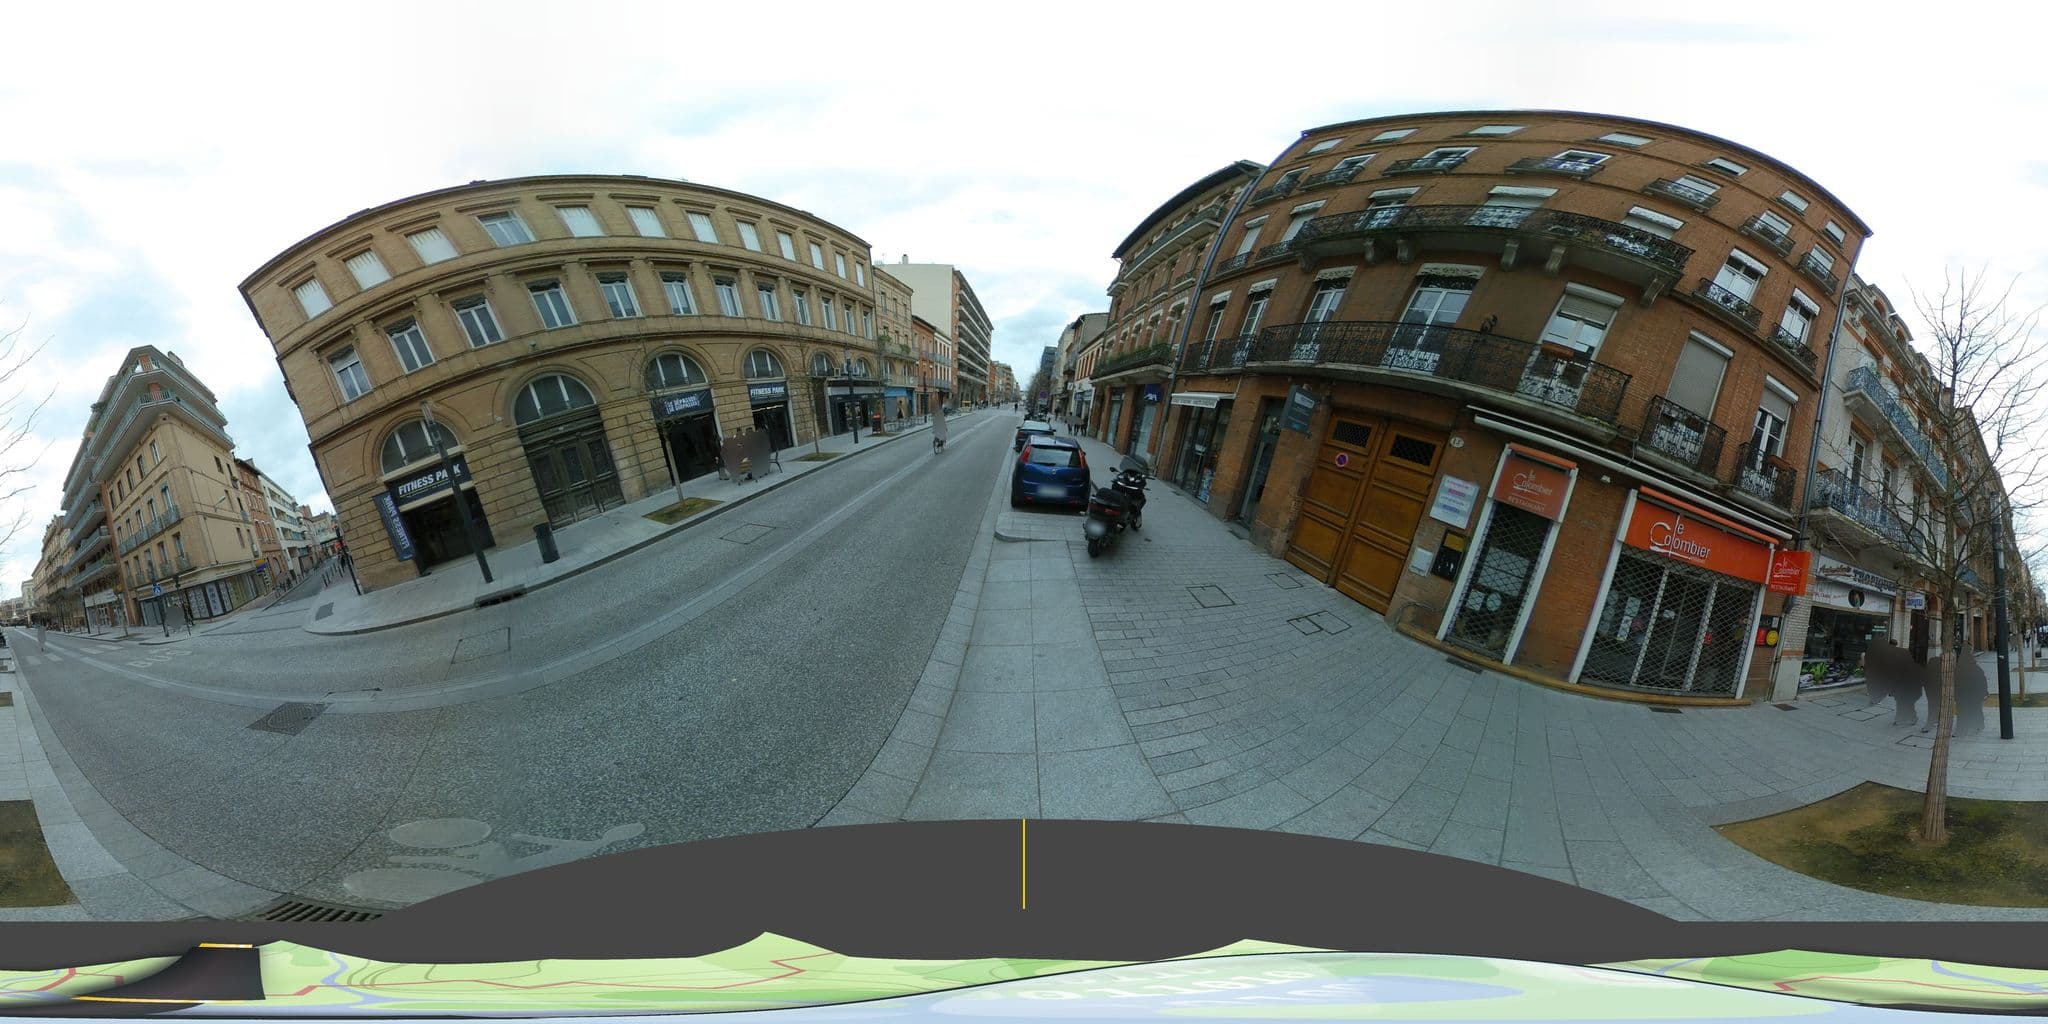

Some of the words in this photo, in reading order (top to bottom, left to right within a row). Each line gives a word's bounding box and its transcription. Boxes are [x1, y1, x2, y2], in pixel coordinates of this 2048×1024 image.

[750, 388, 772, 398] FITNESS
[772, 386, 785, 395] PARK
[398, 474, 434, 496] FITNESS
[435, 463, 461, 481] PAK
[1650, 521, 1711, 559] Colombier
